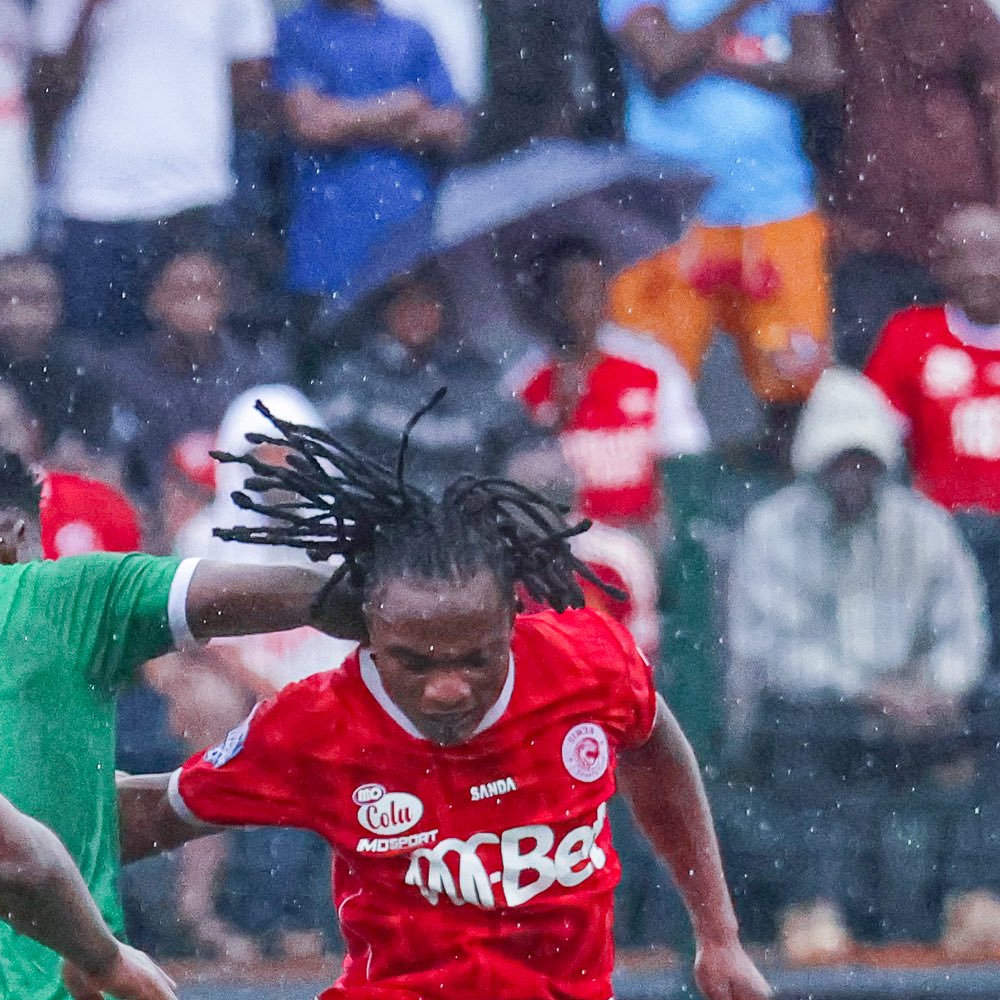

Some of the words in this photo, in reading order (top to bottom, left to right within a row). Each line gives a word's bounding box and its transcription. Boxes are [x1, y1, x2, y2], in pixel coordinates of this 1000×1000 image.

[470, 776, 517, 801] SANDA
[366, 800, 412, 830] Cola
[356, 828, 439, 853] MOSPORT
